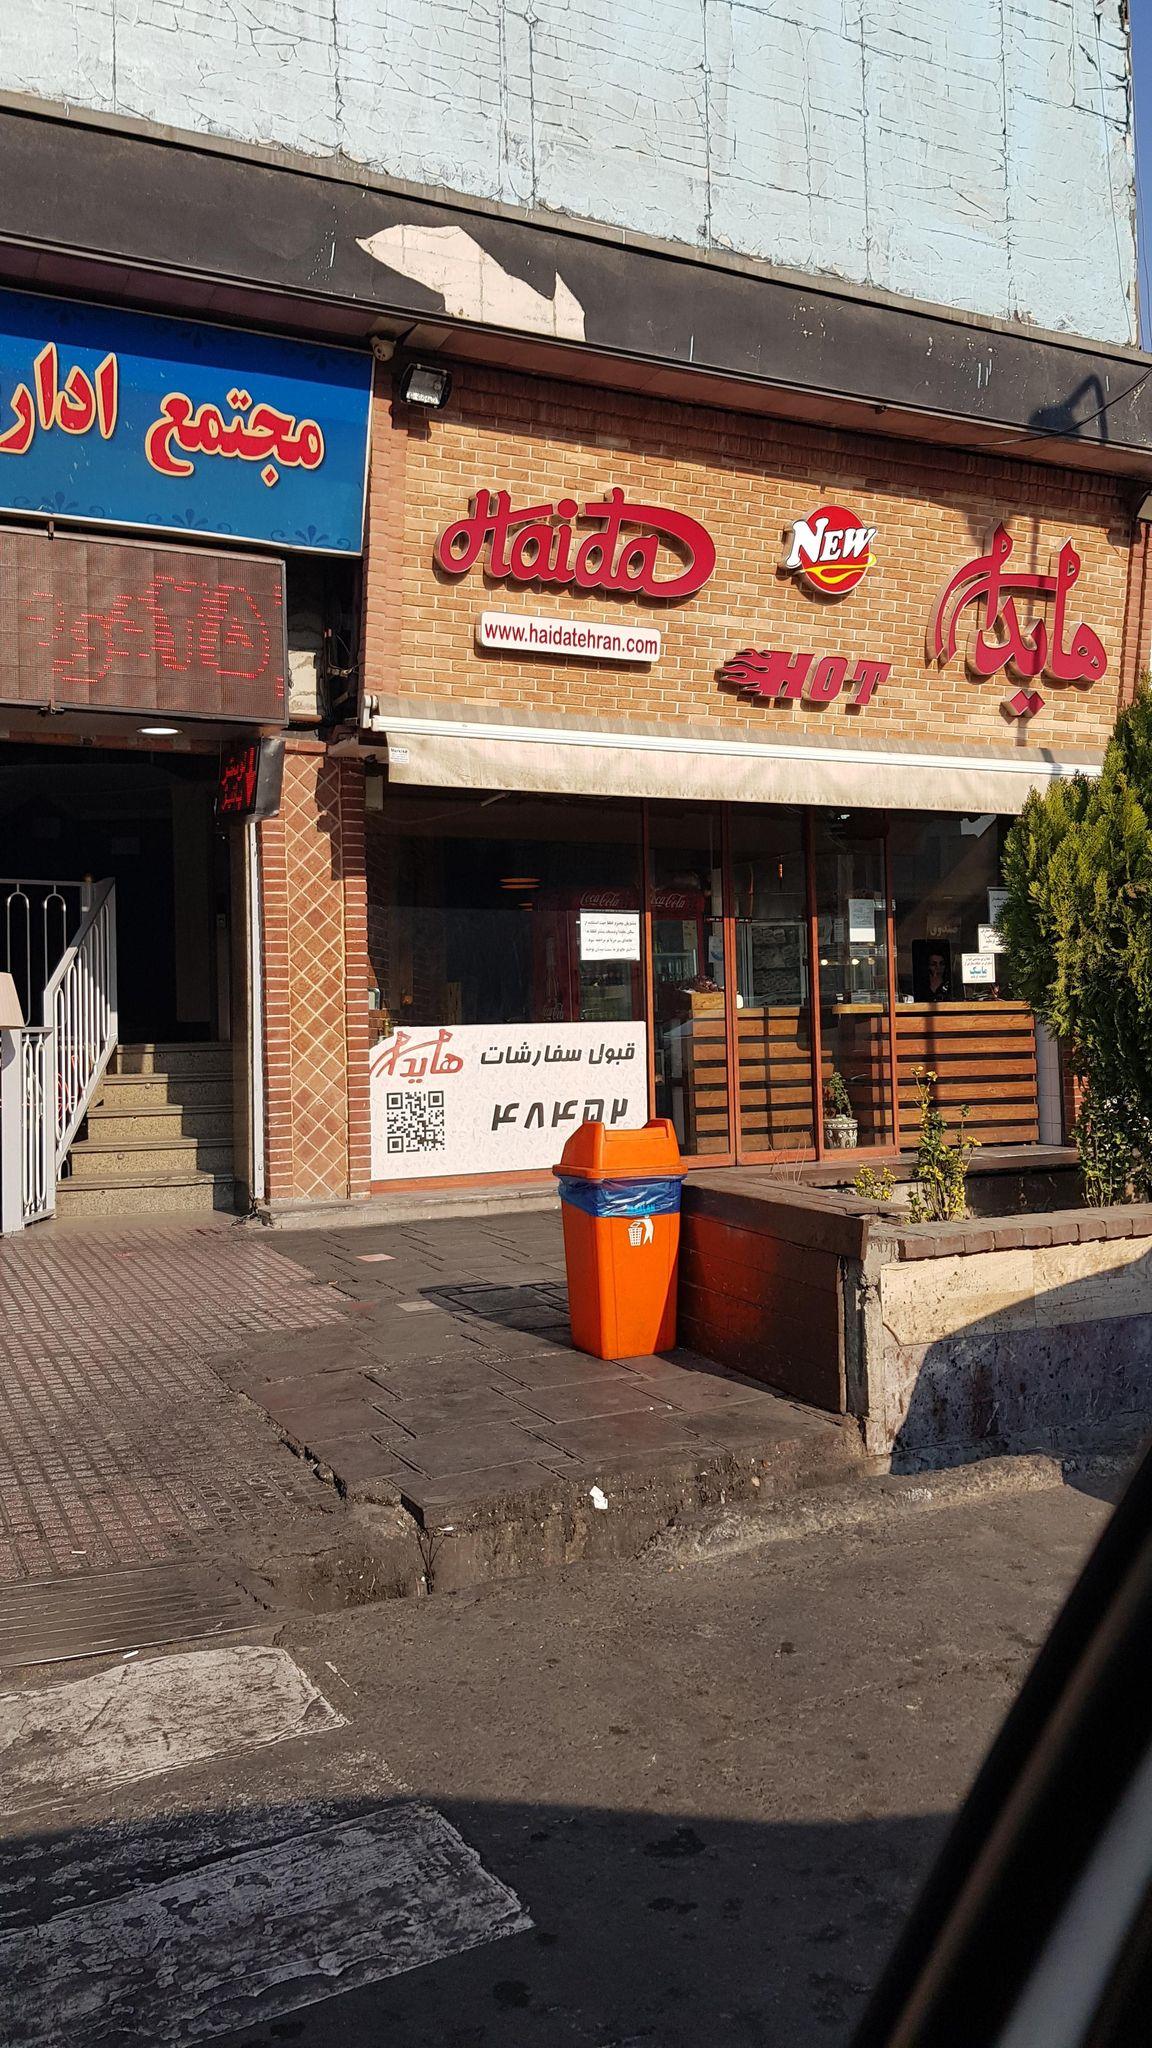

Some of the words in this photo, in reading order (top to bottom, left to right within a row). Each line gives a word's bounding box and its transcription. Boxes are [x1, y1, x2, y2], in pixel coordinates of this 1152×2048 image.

[0, 341, 119, 455] ادار
[145, 387, 325, 488] مجتمع
[436, 486, 717, 598] Haida
[484, 621, 658, 656] www.haidatehran.com
[934, 521, 1108, 718] هایدا
[722, 648, 892, 706] HOT
[369, 1028, 464, 1084] هایدا
[480, 1041, 582, 1066] سفارشات
[588, 1041, 636, 1065] قبول
[491, 1098, 629, 1131] ۴۸۴۵۲
